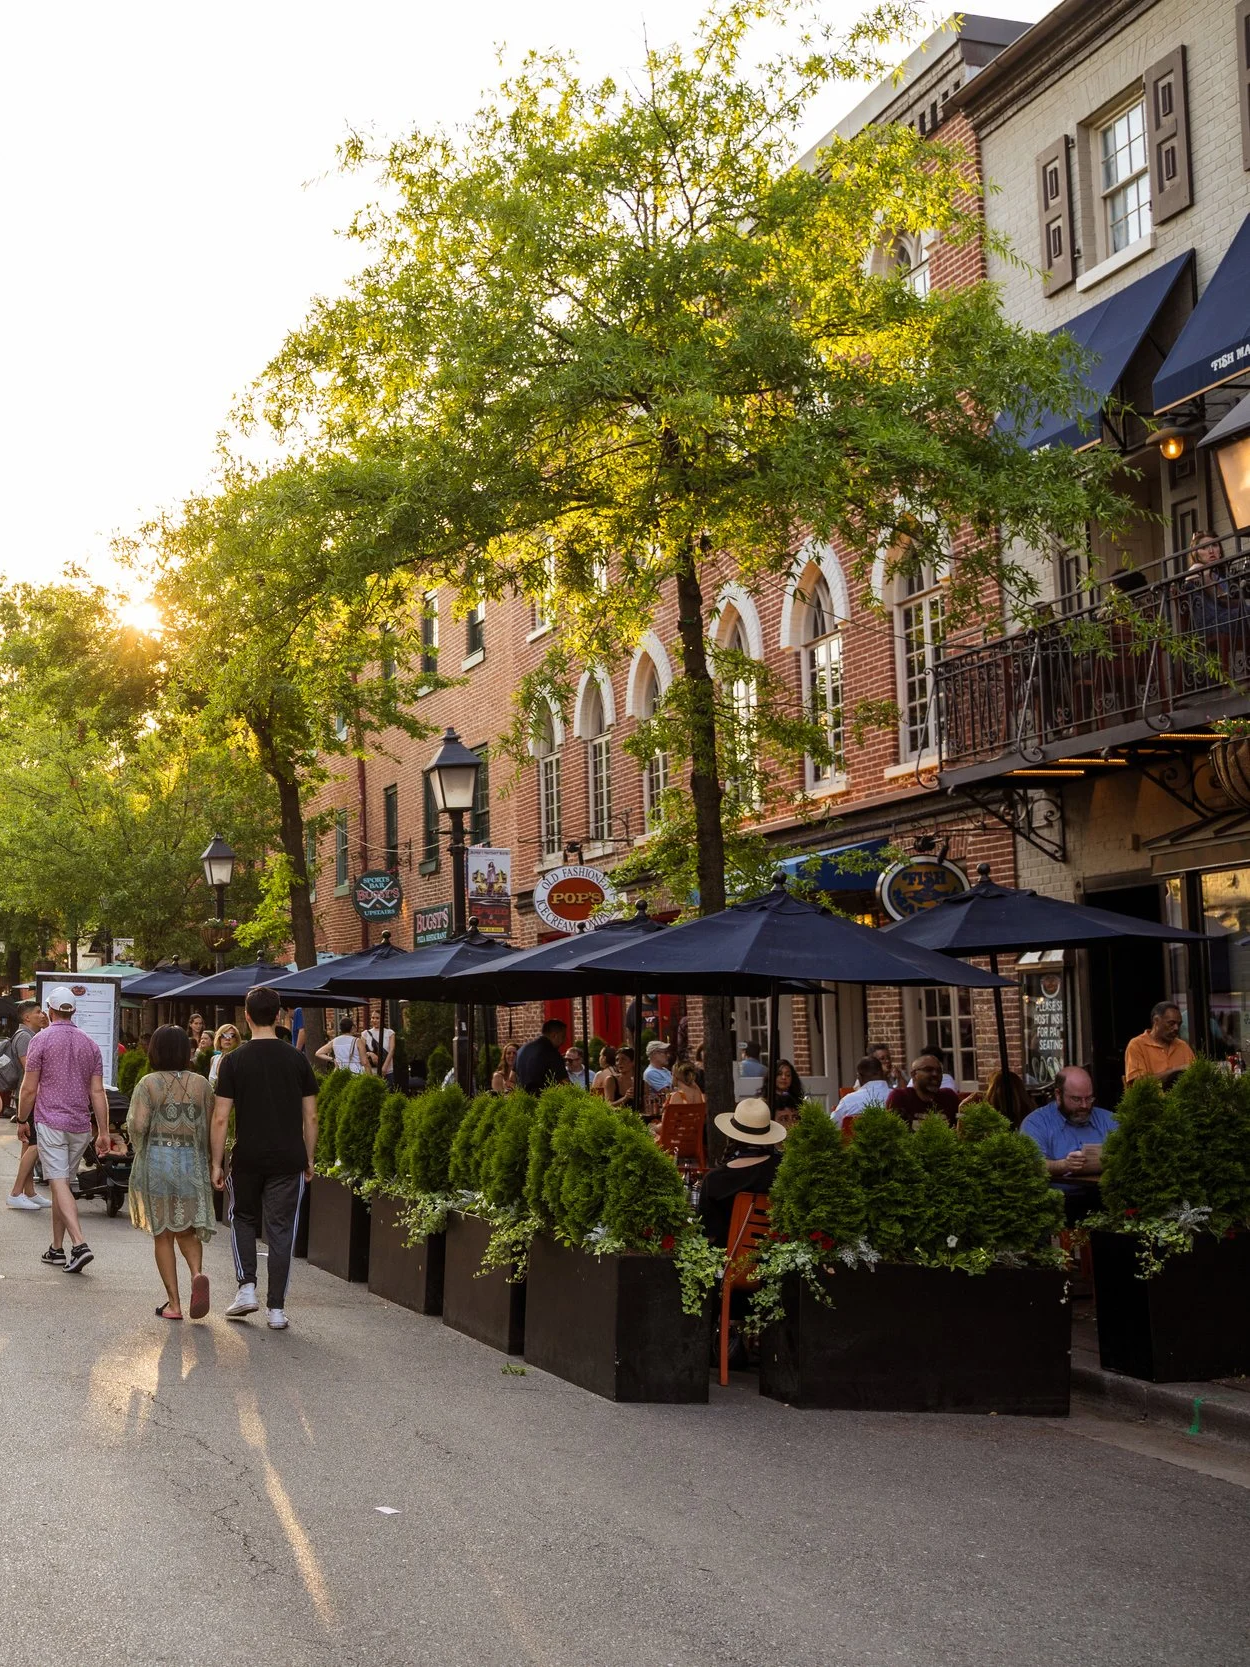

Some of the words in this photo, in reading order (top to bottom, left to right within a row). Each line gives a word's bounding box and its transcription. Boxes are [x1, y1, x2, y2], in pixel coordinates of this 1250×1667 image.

[1210, 351, 1234, 371] FISH
[363, 876, 390, 884] SPORTS
[541, 873, 559, 890] OLD
[562, 866, 610, 891] FASHIONED
[901, 871, 946, 885] FISH
[357, 887, 400, 901] BUGSY'S
[551, 891, 603, 904] POP'S
[536, 899, 548, 916] ICE
[415, 907, 449, 934] BUGSY'S
[546, 911, 577, 932] CREAM
[1034, 1013, 1049, 1025] HOST
[1037, 1027, 1048, 1038] FOR
[1038, 1039, 1063, 1051] SEATING
